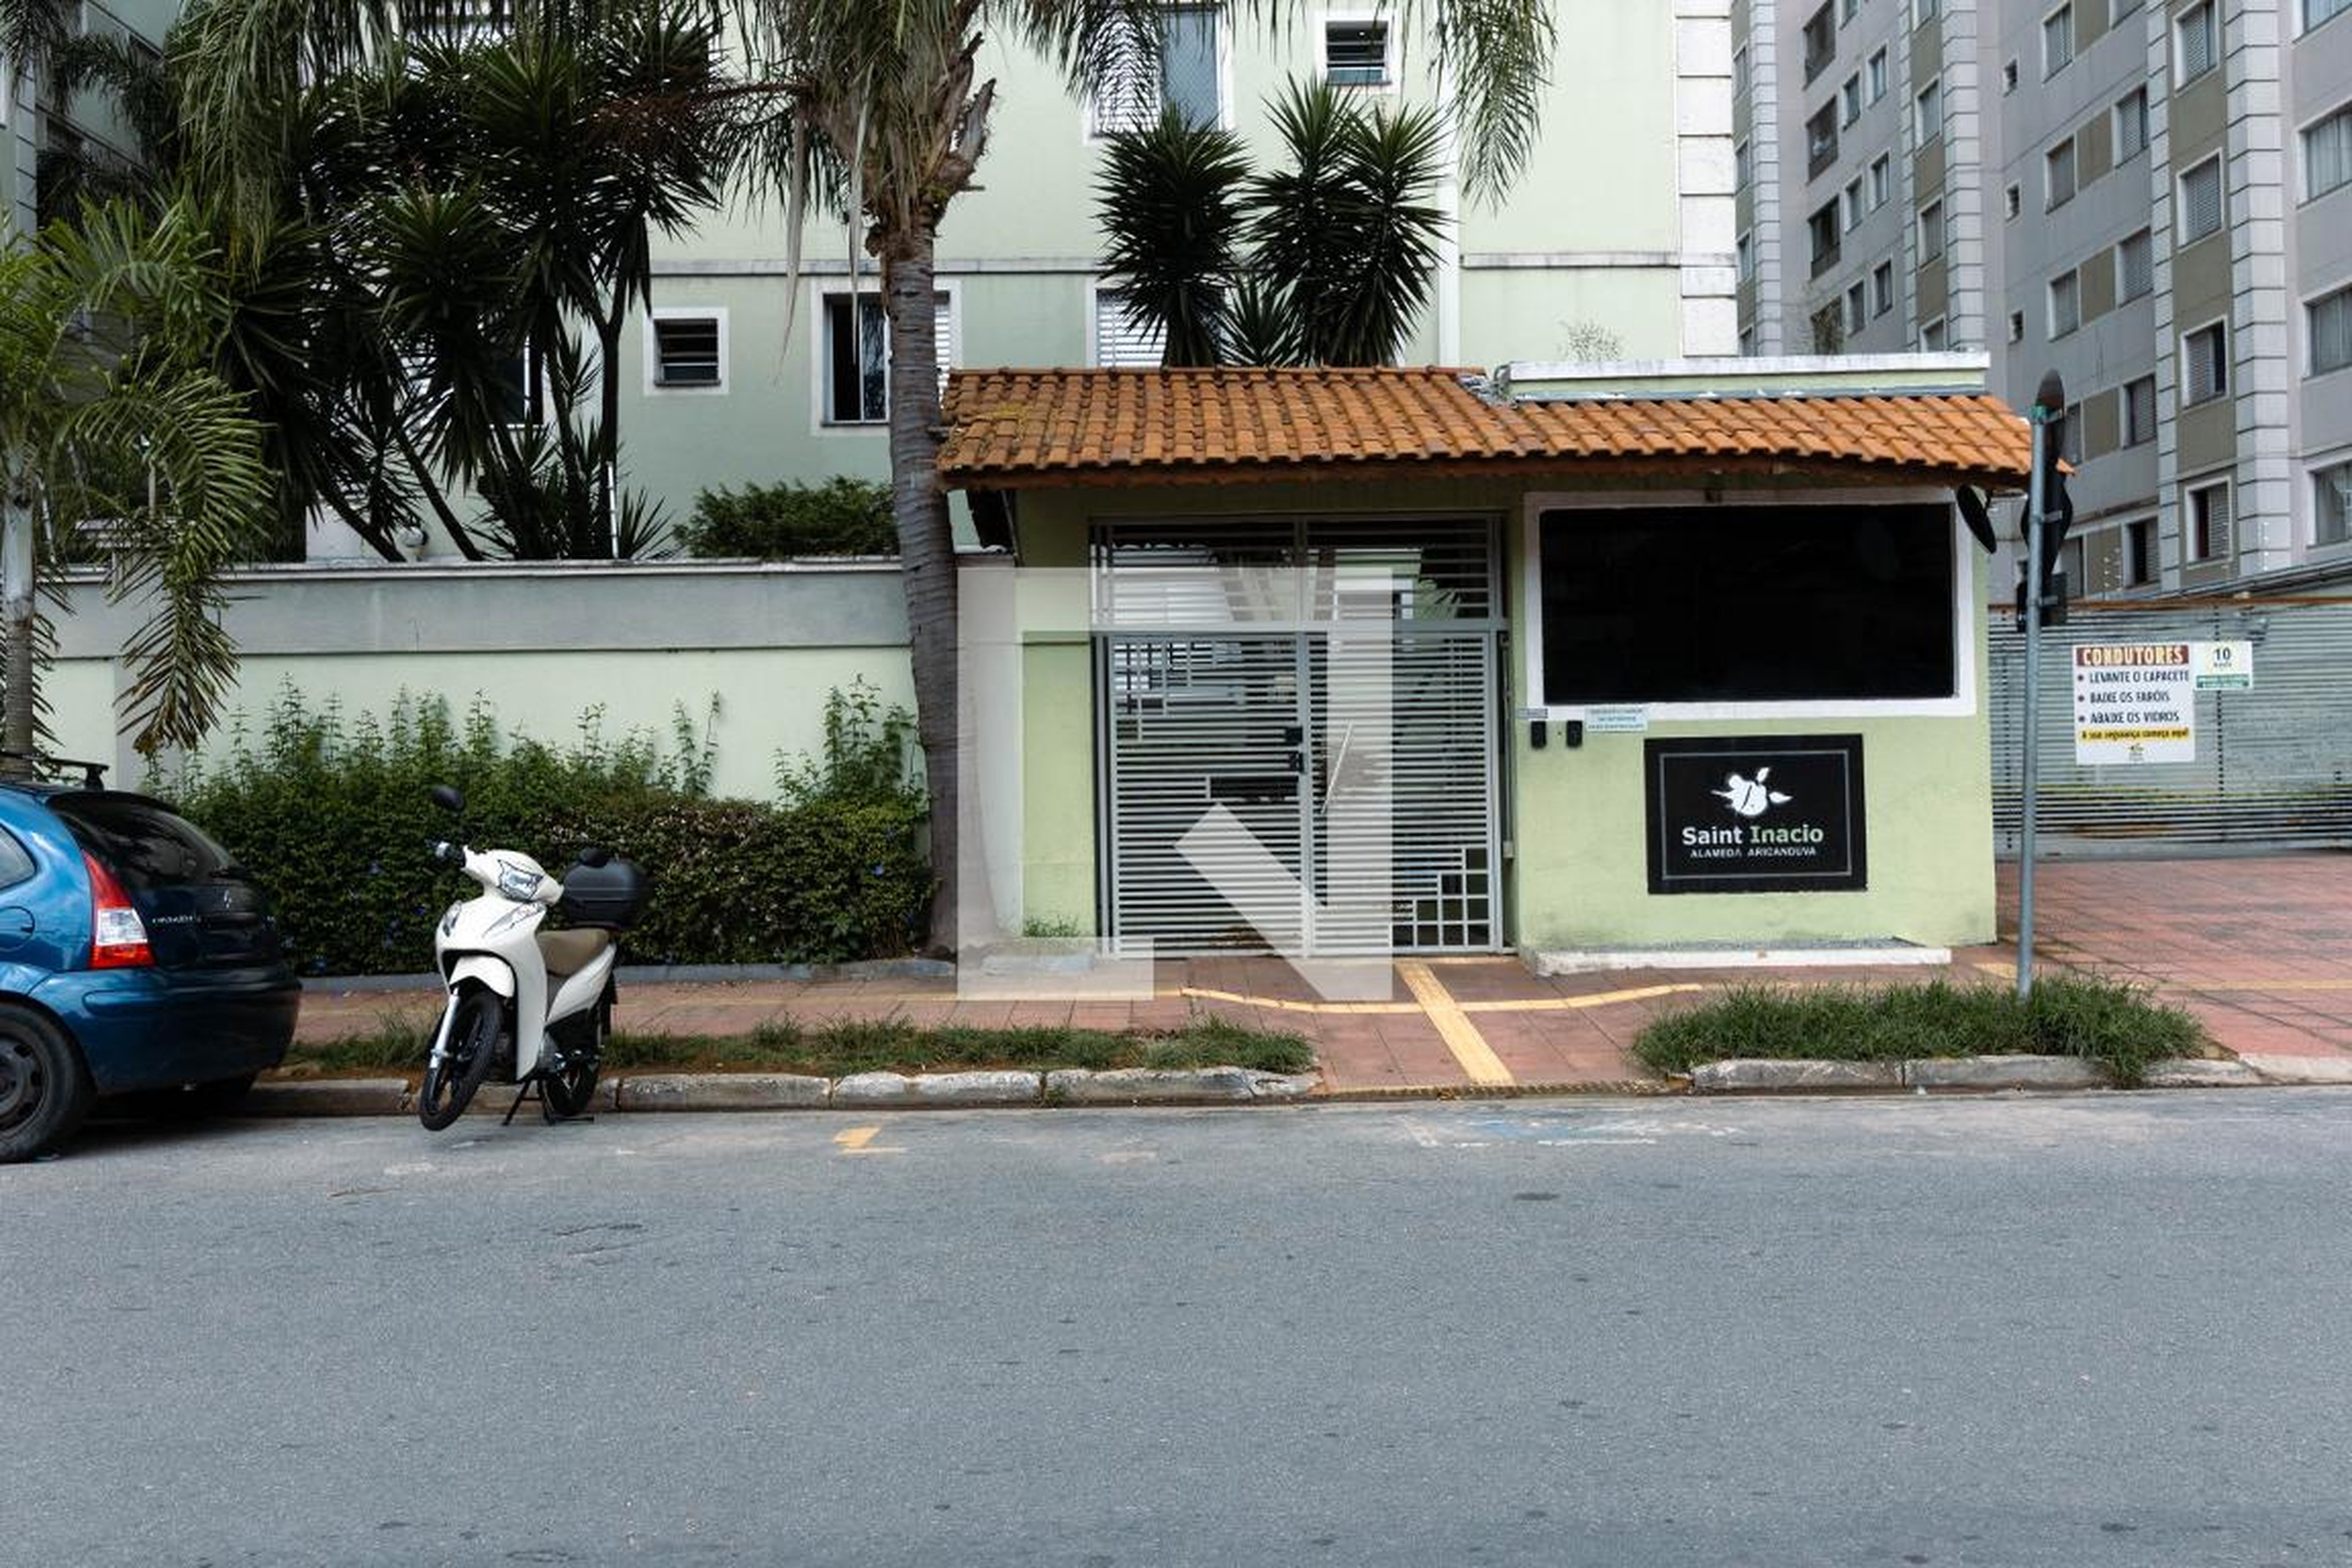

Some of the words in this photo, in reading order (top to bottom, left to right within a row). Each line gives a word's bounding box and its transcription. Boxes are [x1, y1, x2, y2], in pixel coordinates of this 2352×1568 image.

[2084, 647, 2183, 666] CONDUTORES
[2214, 647, 2230, 660] 10
[2090, 671, 2130, 683] LEVANTE
[2133, 671, 2141, 682] O
[2144, 670, 2189, 682] CAPACETE
[2090, 692, 2117, 703] BAIXE
[2119, 692, 2133, 703] OS
[2090, 712, 2124, 723] ABAIXE
[2127, 712, 2140, 723] OS
[2144, 711, 2179, 722] VIDROS
[1682, 826, 1743, 845] Saint
[1690, 848, 1742, 858] ALAMEDA
